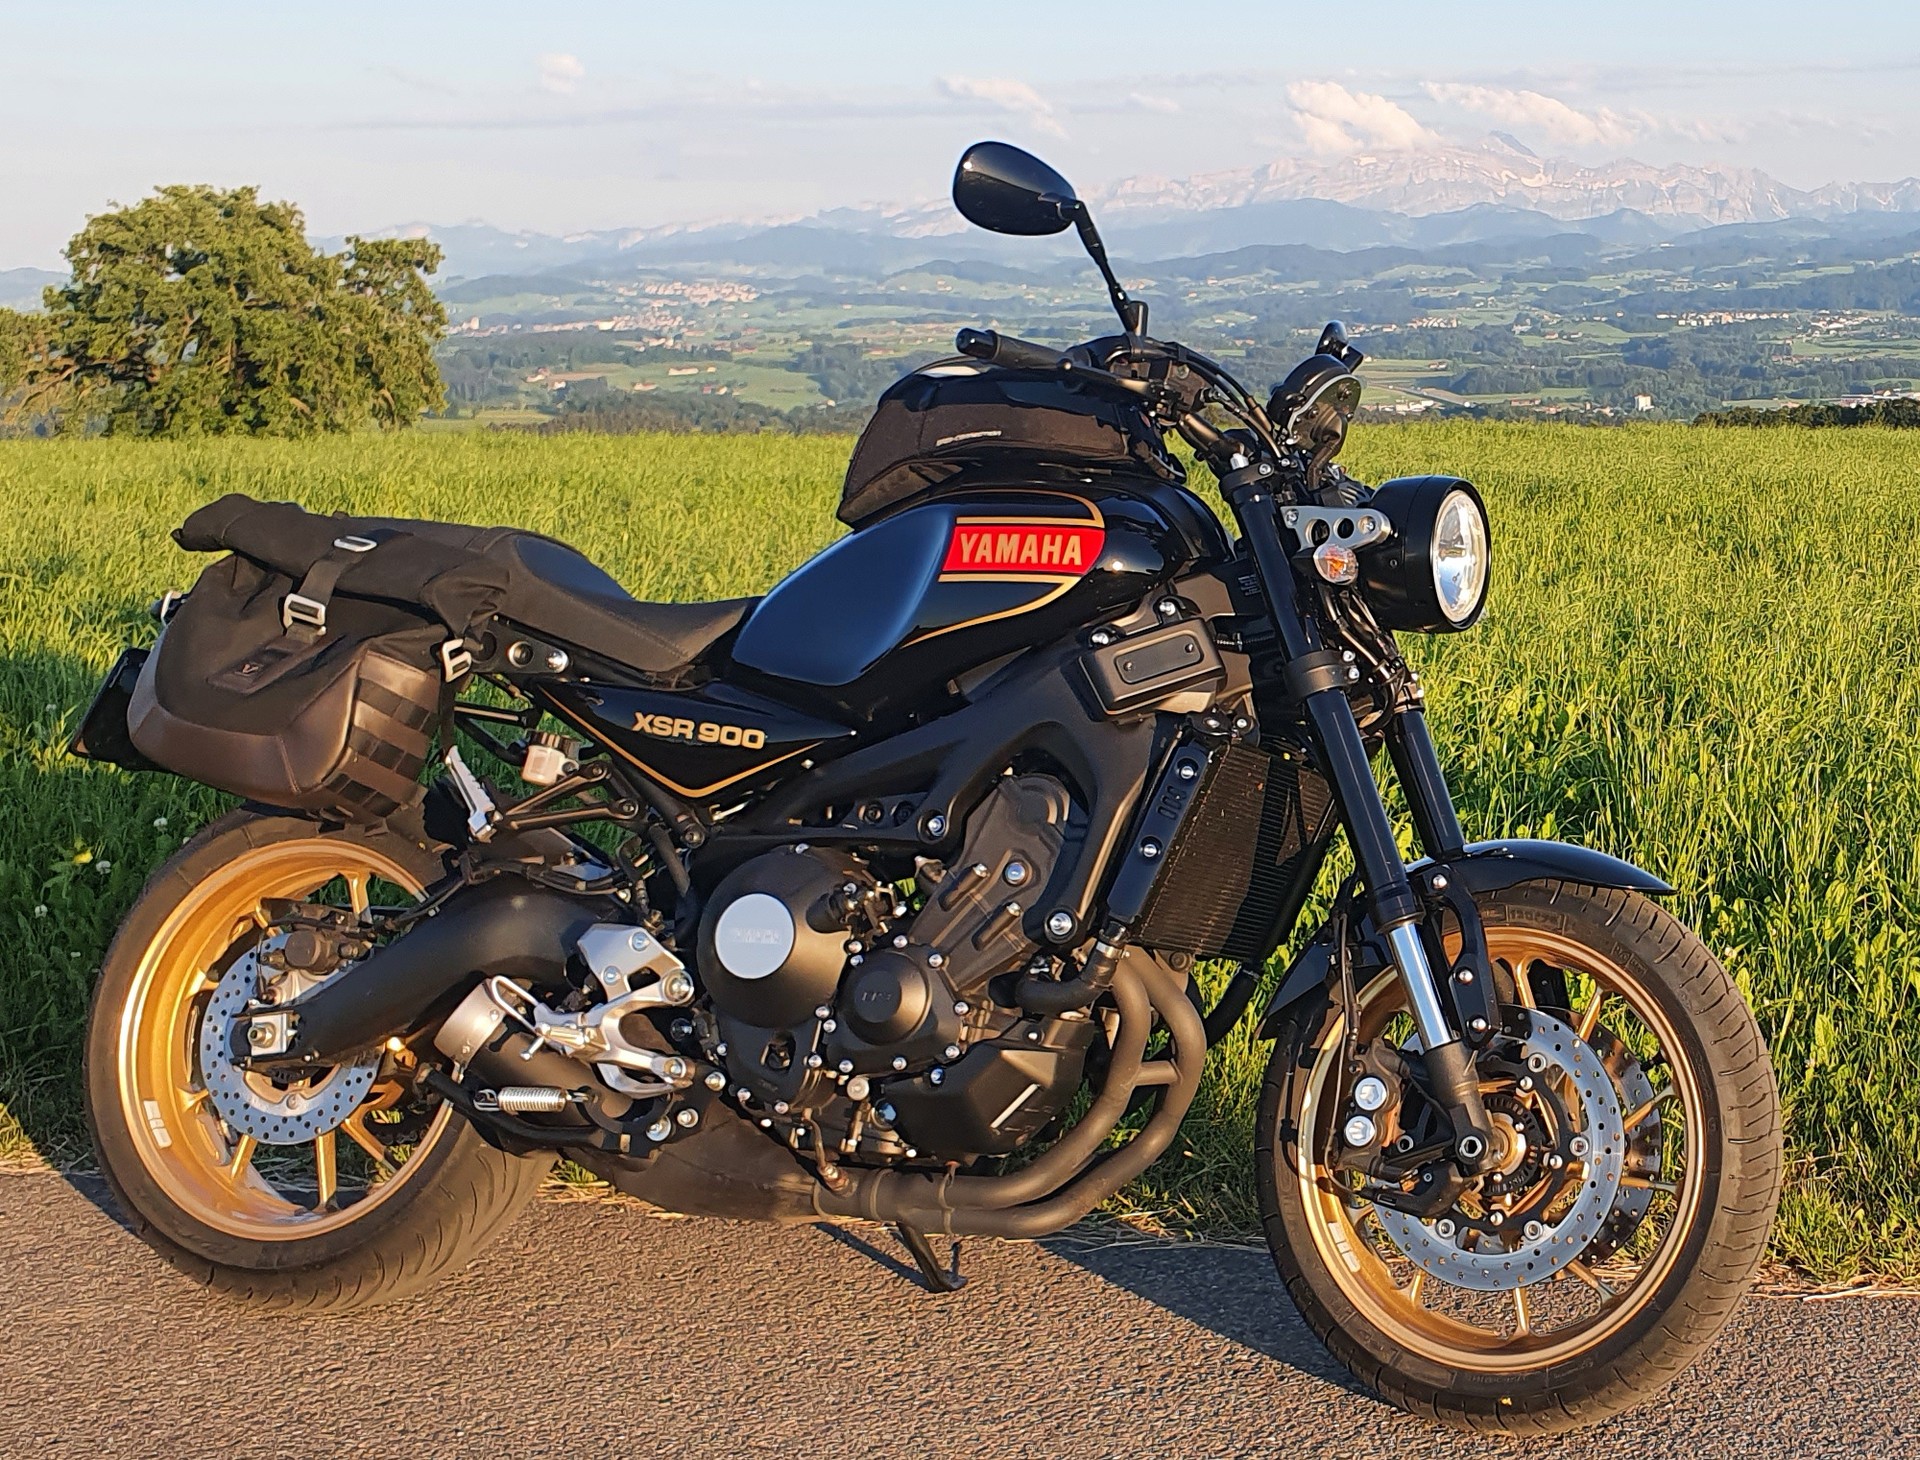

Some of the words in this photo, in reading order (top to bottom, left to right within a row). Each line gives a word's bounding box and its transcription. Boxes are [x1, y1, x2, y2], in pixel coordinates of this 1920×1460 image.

[960, 533, 1082, 566] YAMAHA
[632, 711, 695, 740] XSR
[698, 721, 766, 750] 900
